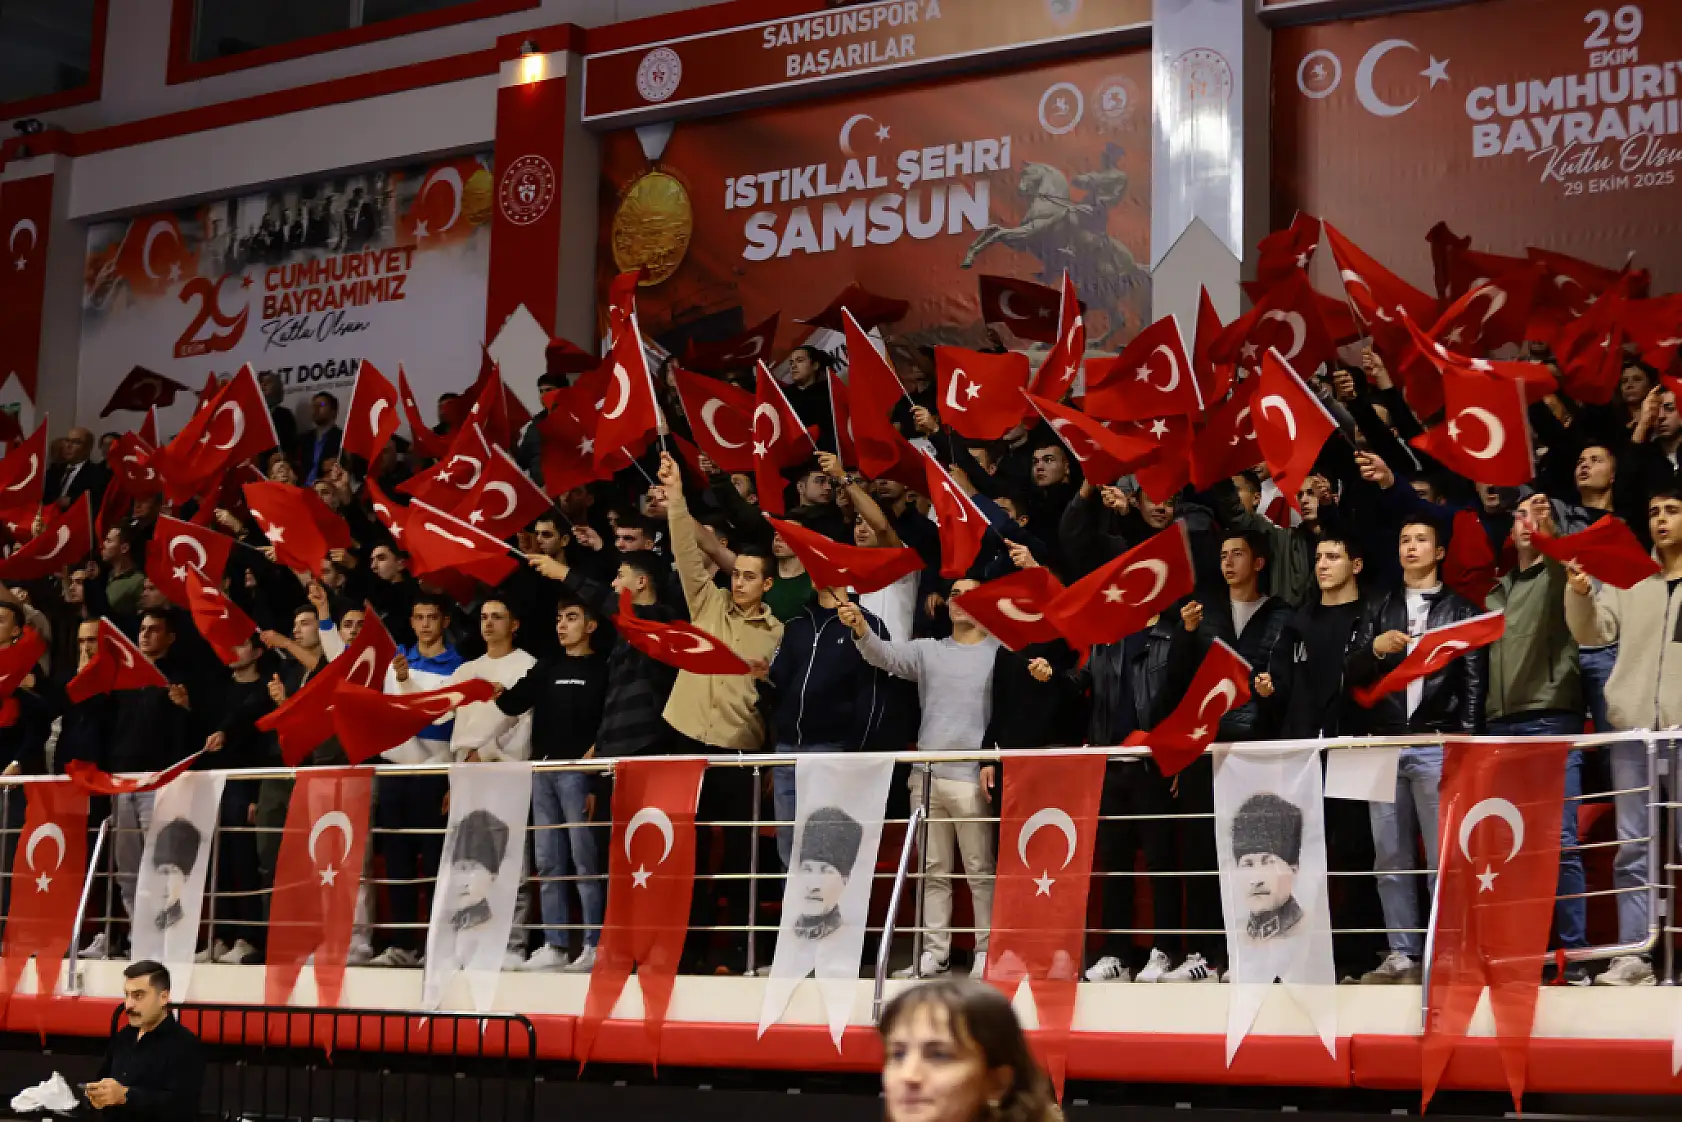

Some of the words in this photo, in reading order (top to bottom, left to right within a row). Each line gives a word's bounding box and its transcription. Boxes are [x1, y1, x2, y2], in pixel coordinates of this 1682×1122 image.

[762, 0, 942, 50] SAMSUNSPOR'A
[1583, 5, 1643, 49] 29
[786, 34, 916, 78] BAŞARILAR
[1465, 60, 1682, 121] CUMHURİ
[1472, 100, 1682, 158] BAYRAMI
[724, 154, 888, 211] İSTİKLAL
[895, 135, 1011, 191] ŞEHRİ
[1527, 137, 1614, 184] Kutlu
[1618, 131, 1682, 172] Olsu
[1563, 180, 1583, 197] 29
[1588, 172, 1629, 194] EKİM
[1633, 169, 1675, 189] 2025
[742, 179, 992, 262] SAMSUN
[263, 244, 417, 293] CUMHURİYET
[262, 274, 407, 320] BAYRAMIMIZ
[316, 309, 370, 343] Olsun
